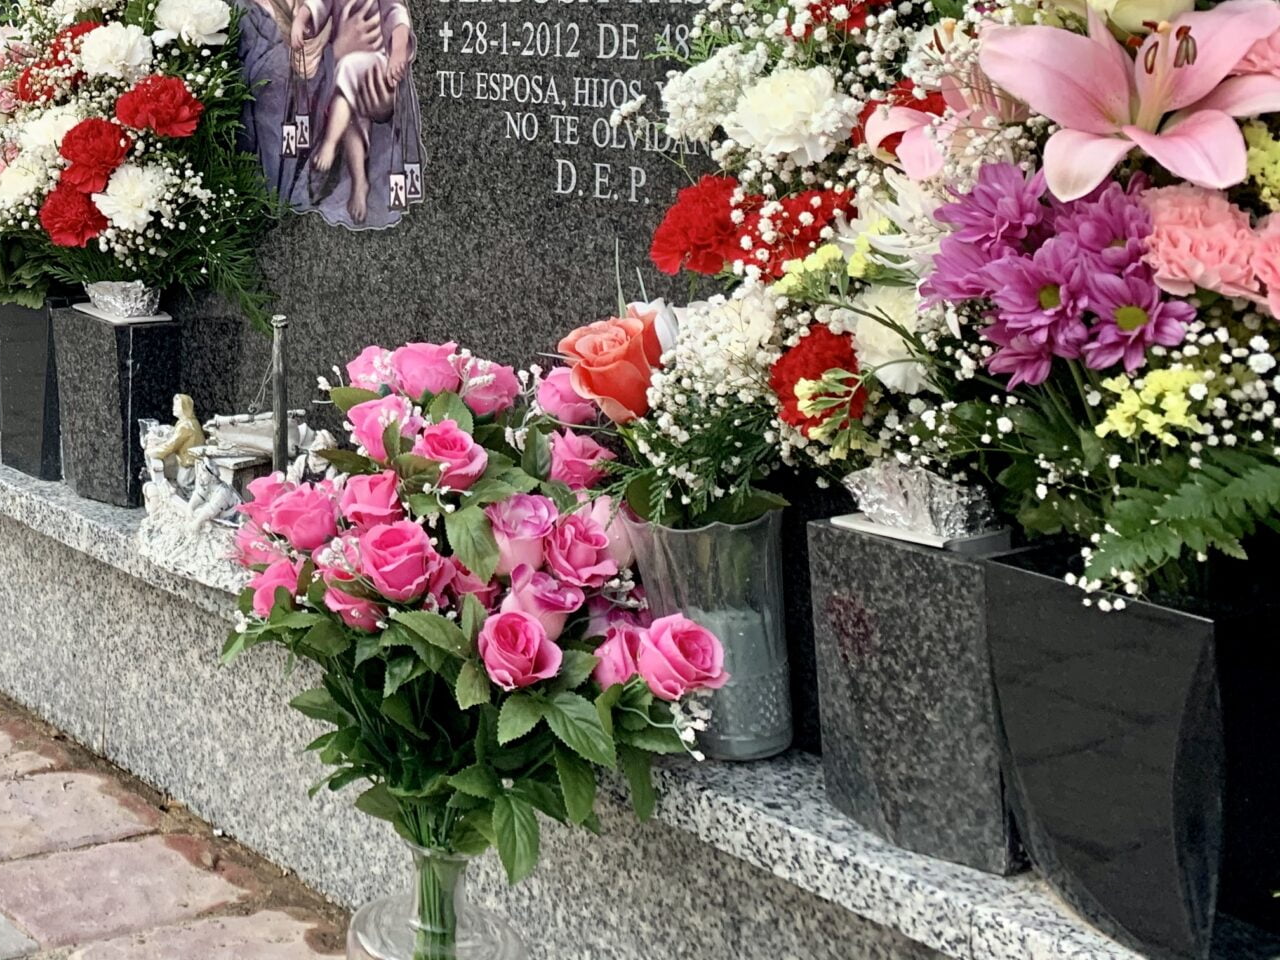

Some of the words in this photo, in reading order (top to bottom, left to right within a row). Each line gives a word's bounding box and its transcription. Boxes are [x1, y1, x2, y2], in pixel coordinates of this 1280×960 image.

[460, 20, 580, 58] 28-1-2012
[596, 23, 640, 60] DE
[655, 24, 691, 62] 48
[436, 70, 465, 98] TU
[474, 72, 567, 111] ESPOSA,
[572, 76, 643, 108] HIJOS
[505, 111, 539, 141] NO
[550, 114, 580, 144] TE
